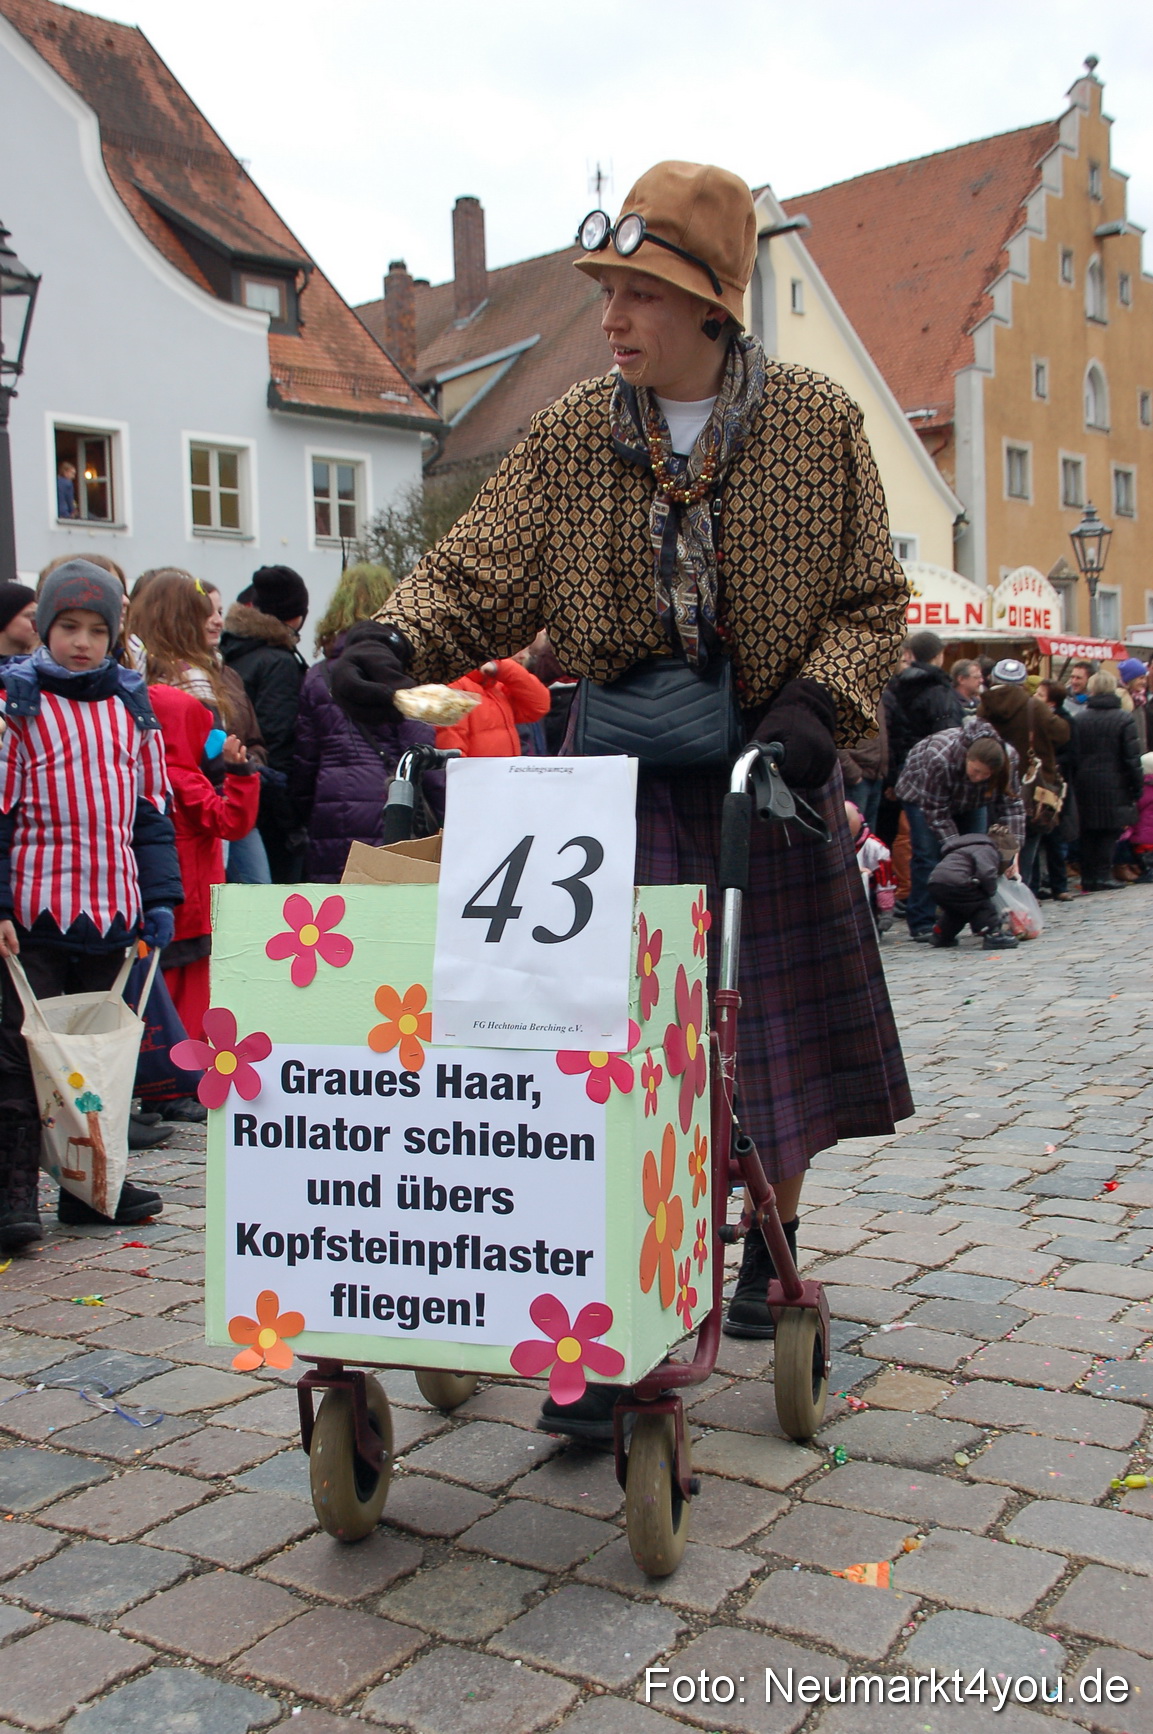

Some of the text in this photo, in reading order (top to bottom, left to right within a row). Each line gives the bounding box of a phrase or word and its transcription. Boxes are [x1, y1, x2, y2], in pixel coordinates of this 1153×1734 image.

[1050, 641, 1113, 659] POPCORN
[461, 835, 604, 944] 43
[472, 1020, 583, 1034] FG Hechtonia Berching e.V.
[280, 1059, 541, 1110] Graues Haar,
[233, 1113, 595, 1162] Rollator schieben
[307, 1174, 515, 1215] und übers
[236, 1222, 594, 1277] Kopfsteinpflaster
[330, 1283, 485, 1331] fliegen!
